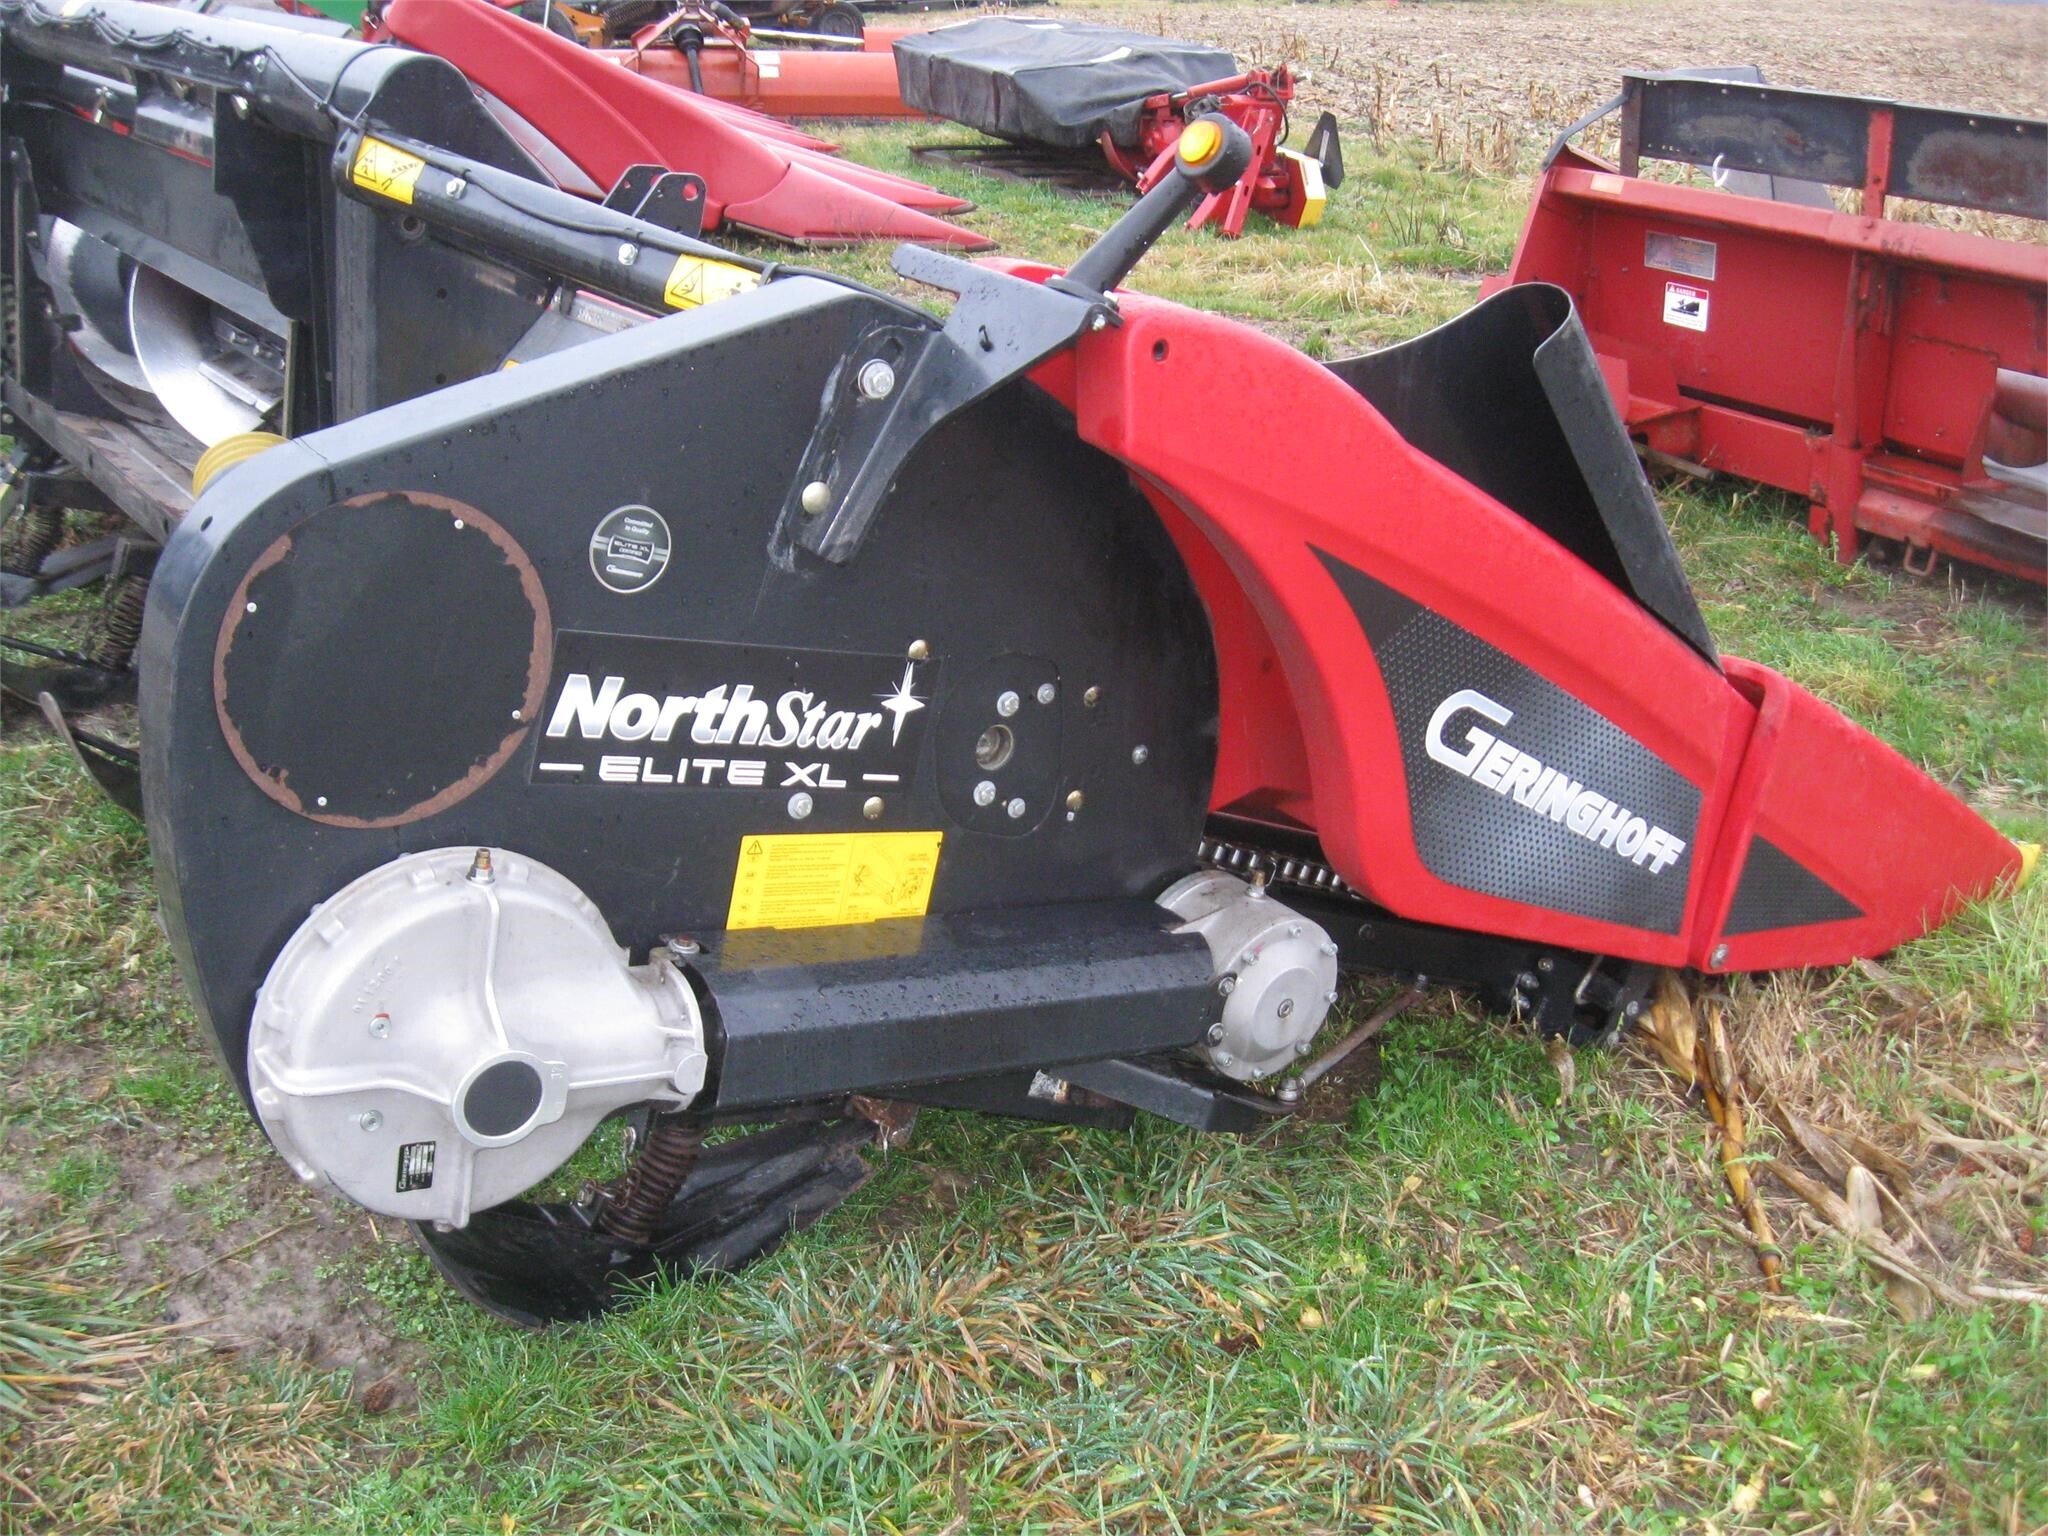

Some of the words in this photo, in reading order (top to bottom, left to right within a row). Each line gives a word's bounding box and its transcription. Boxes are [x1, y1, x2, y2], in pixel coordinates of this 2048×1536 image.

[614, 541, 638, 549] ELITE
[631, 525, 650, 535] Quality
[545, 672, 882, 750] NorthStar
[598, 755, 767, 786] ELITE
[780, 761, 848, 788] XL
[1425, 689, 1686, 875] GERINGHOFF
